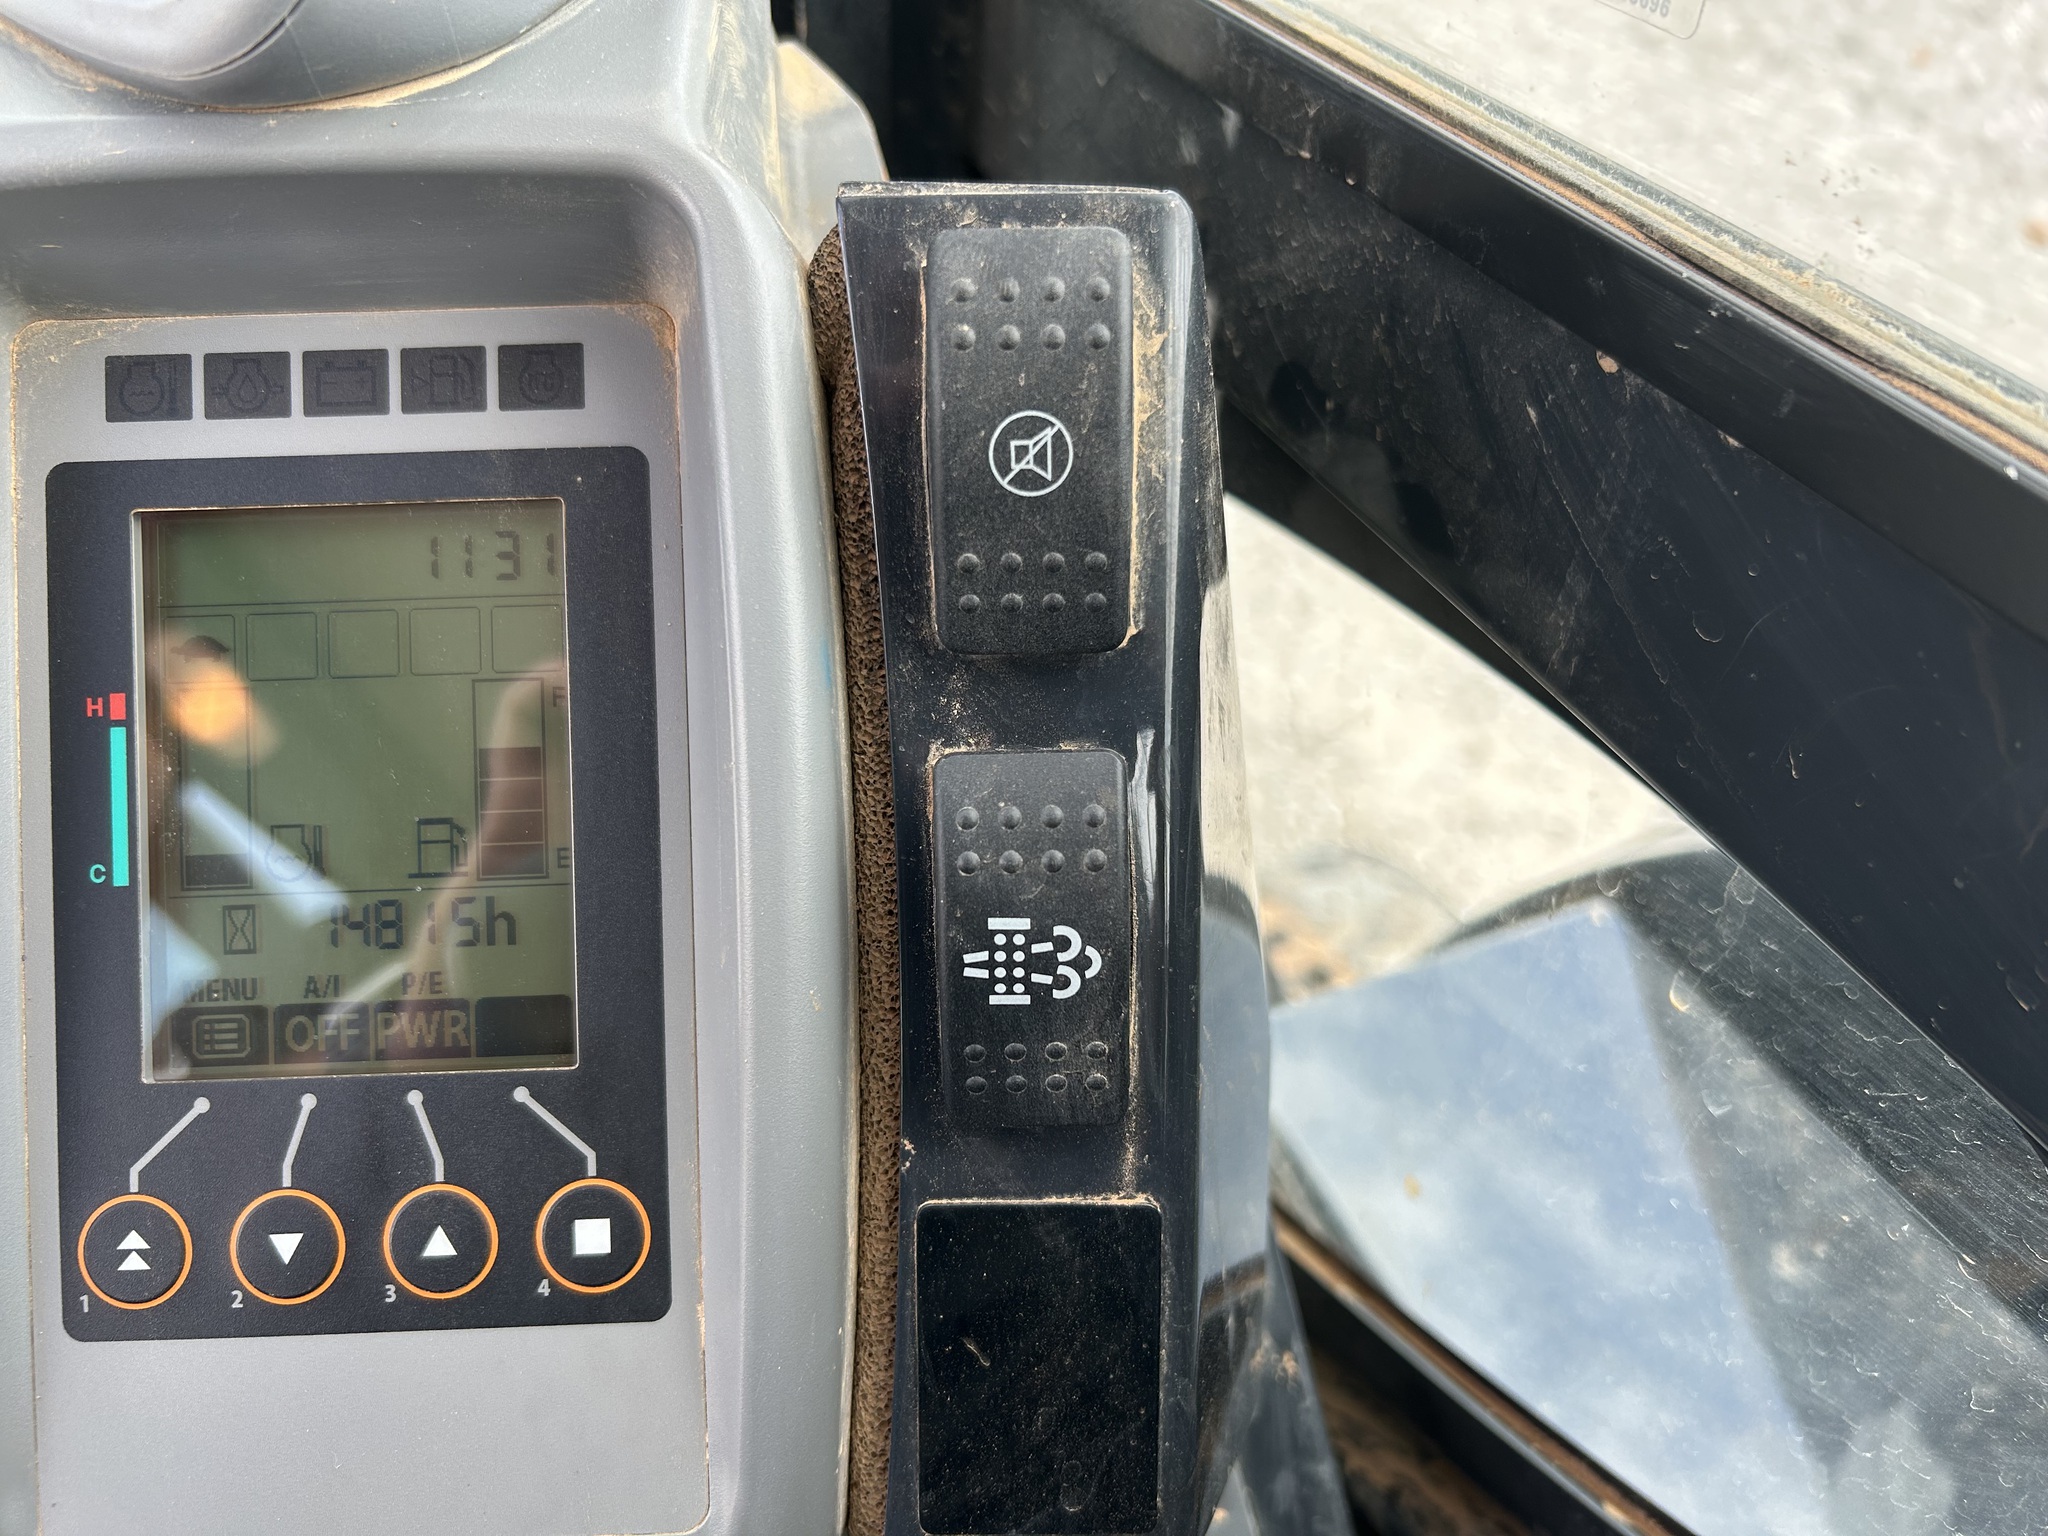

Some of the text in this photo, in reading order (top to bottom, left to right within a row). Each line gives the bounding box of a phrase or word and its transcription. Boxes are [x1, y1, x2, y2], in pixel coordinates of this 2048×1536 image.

[430, 531, 555, 581] 1131
[86, 697, 103, 717] H
[556, 847, 570, 869] E
[89, 863, 106, 884] C
[184, 978, 258, 1003] MENU
[304, 975, 340, 999] A/I
[402, 971, 442, 995] P/E
[285, 1013, 360, 1052] OFF
[377, 1009, 470, 1050] PWR
[384, 1284, 397, 1303] 3
[537, 1278, 551, 1297] 4
[79, 1294, 90, 1313] 1
[231, 1290, 244, 1309] 2
